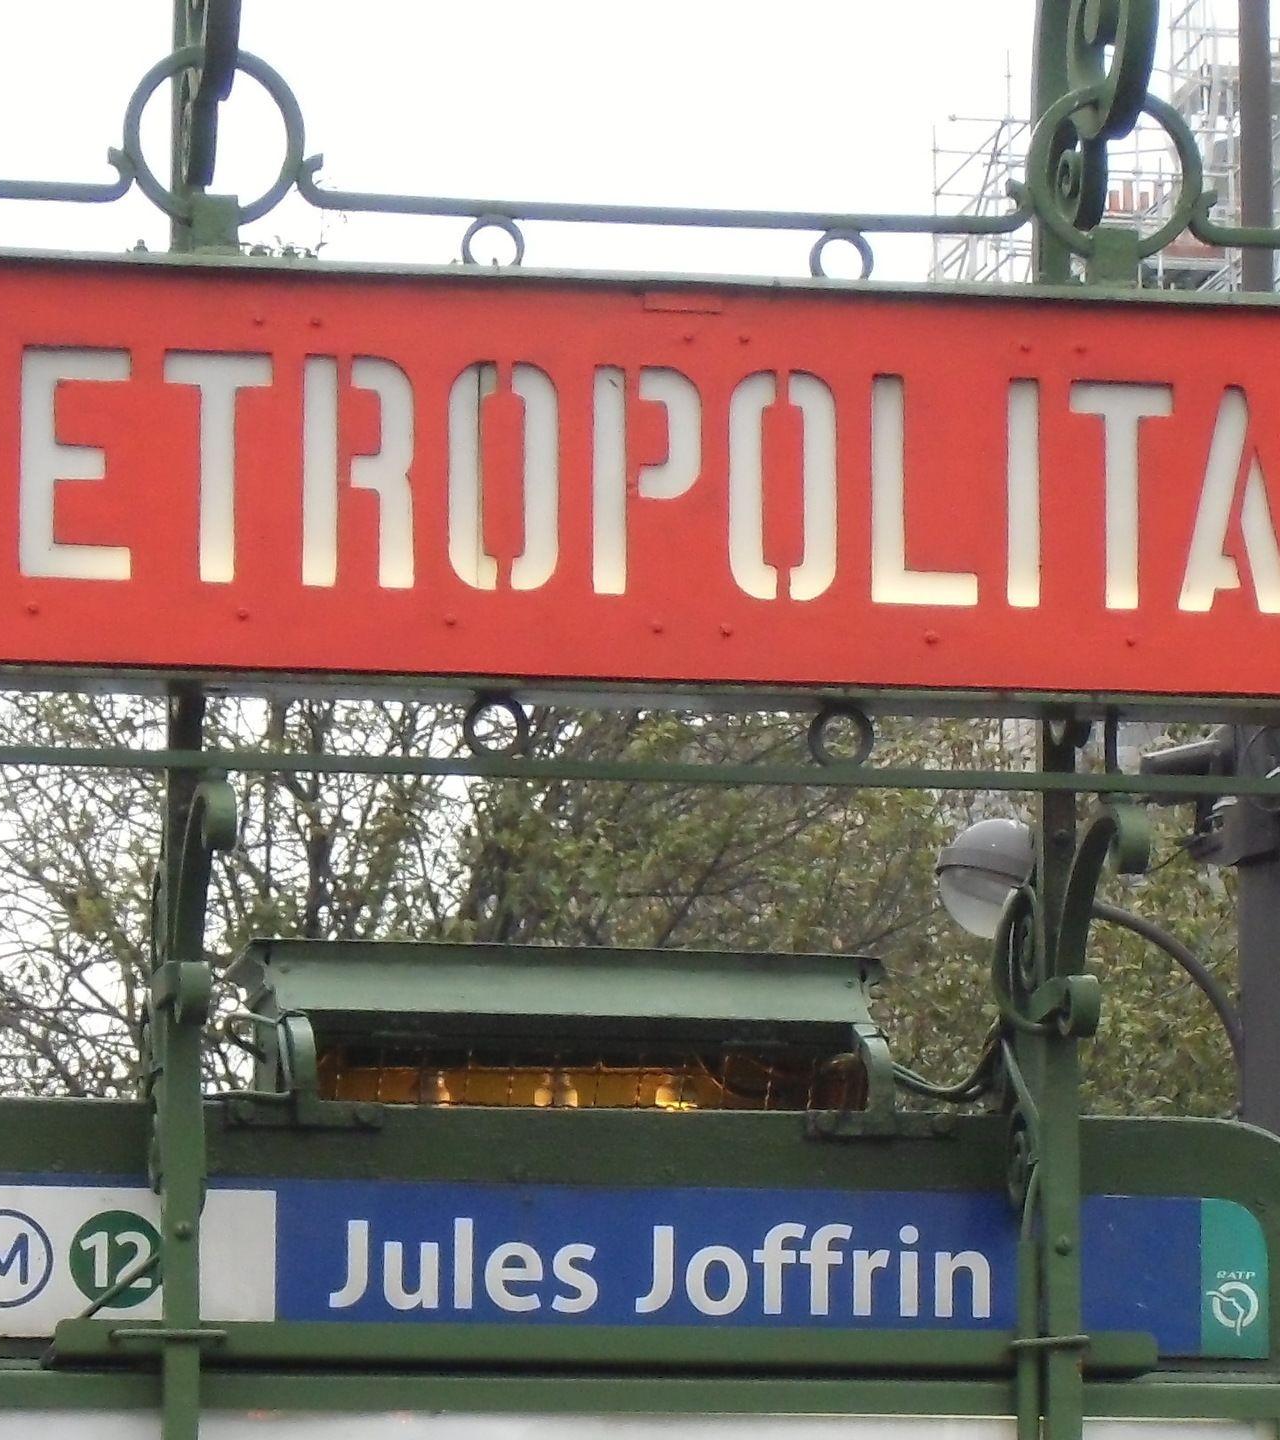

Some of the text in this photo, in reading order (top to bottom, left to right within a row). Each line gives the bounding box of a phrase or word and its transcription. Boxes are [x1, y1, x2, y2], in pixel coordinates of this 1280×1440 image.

[78, 1231, 154, 1290] 12
[328, 1217, 991, 1319] Jules Joffrin
[1216, 1270, 1256, 1280] RATP
